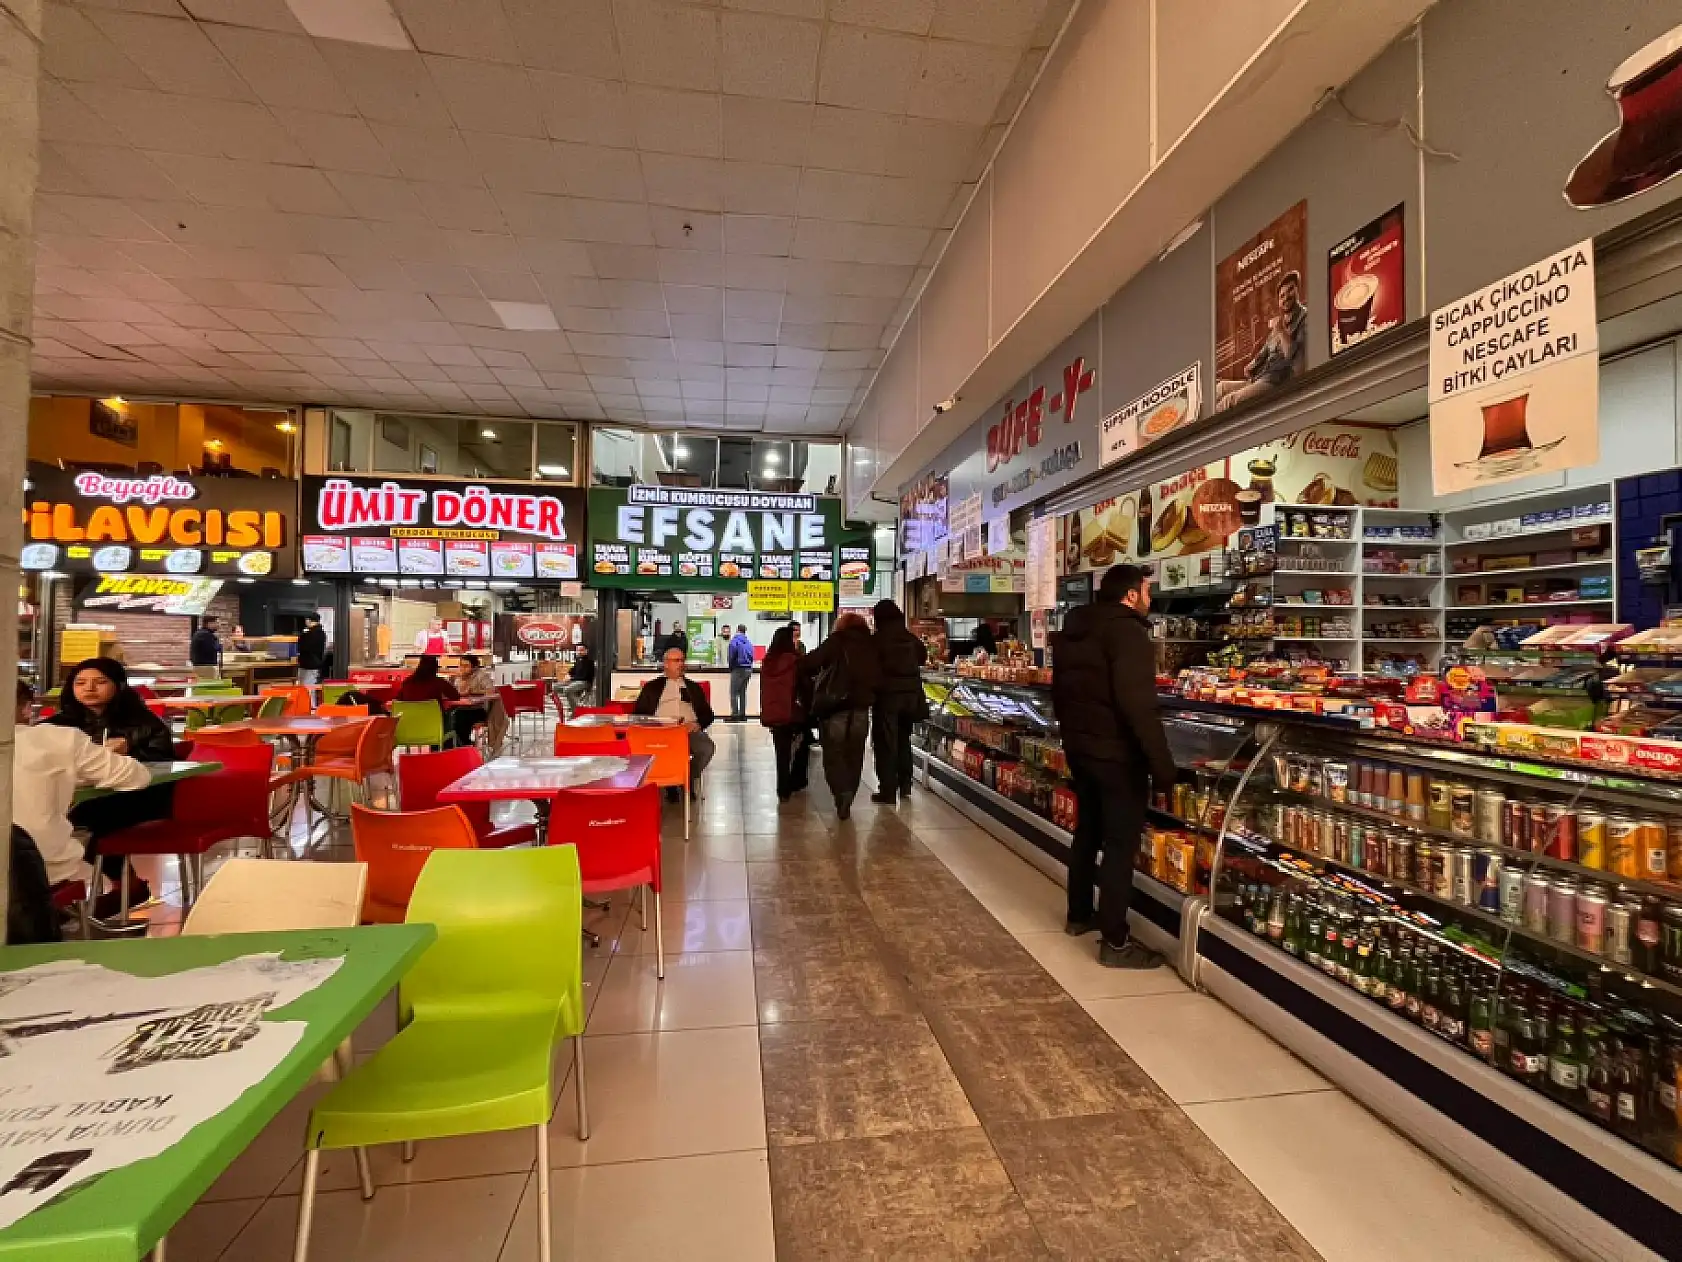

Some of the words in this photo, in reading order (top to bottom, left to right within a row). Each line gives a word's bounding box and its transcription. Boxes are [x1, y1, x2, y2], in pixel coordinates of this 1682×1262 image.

[1434, 296, 1485, 332] SICAK
[1490, 250, 1588, 311] ÇİKOLATA
[1448, 285, 1570, 347] CAPPUCCİNO
[1443, 361, 1486, 394] BİTKİ
[1492, 333, 1578, 380] ÇAYLARI
[1463, 316, 1550, 364] NESCAFE
[76, 473, 195, 503] Beyoğlu
[320, 479, 424, 528] ÜMİT
[434, 487, 564, 538] DÖNER
[22, 502, 282, 547] İLAVCISI
[616, 505, 826, 552] EFSANE
